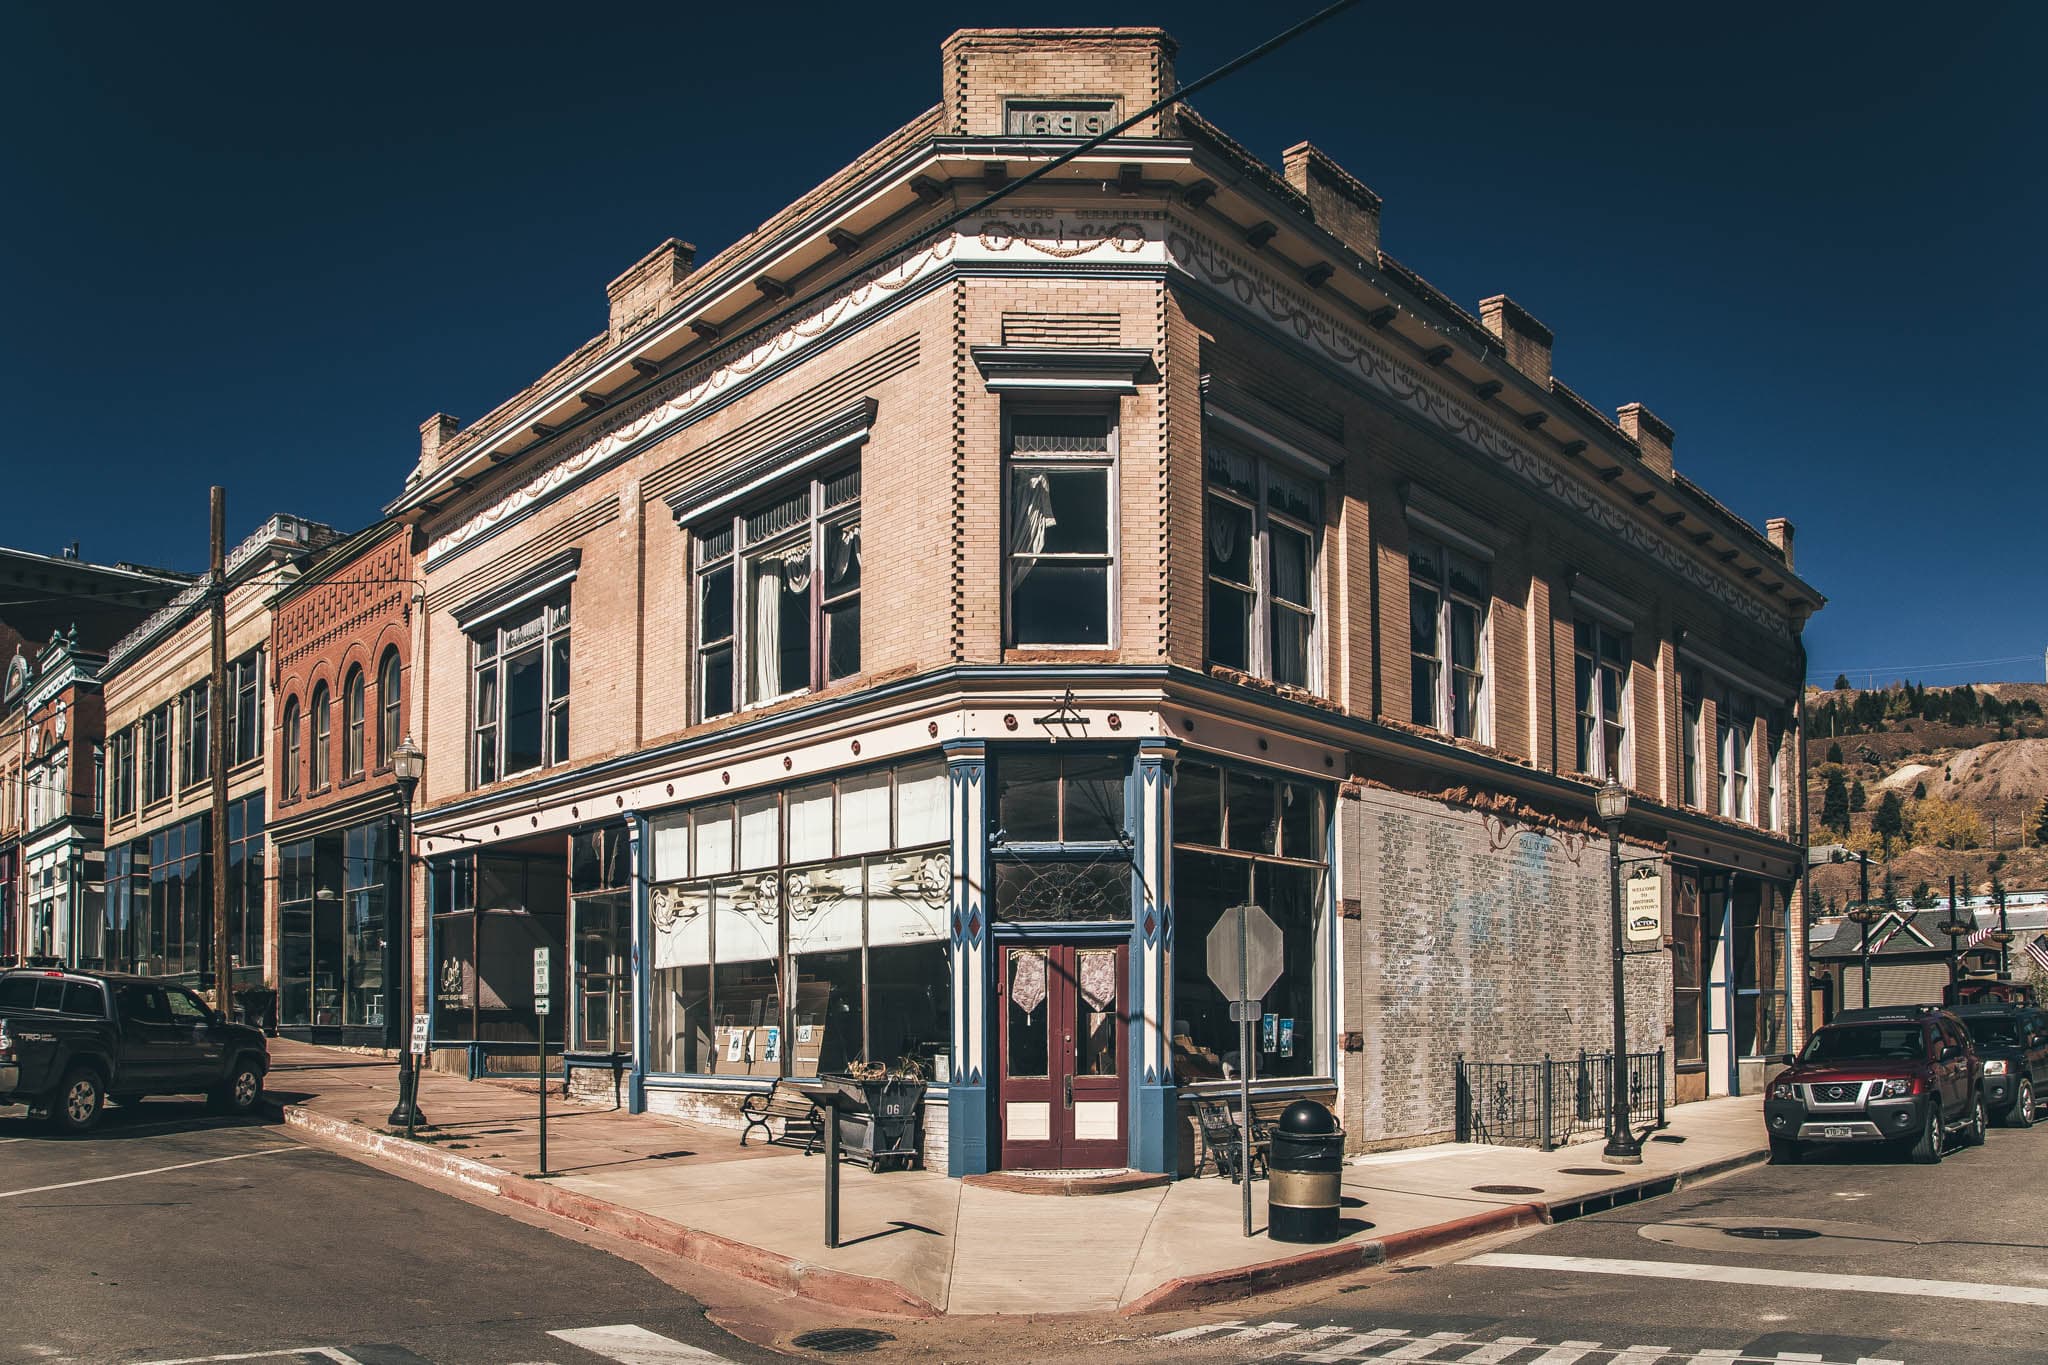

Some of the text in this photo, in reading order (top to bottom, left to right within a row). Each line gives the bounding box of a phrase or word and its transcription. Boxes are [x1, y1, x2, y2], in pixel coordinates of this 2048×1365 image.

[1014, 113, 1105, 136] 1899
[1520, 838, 1532, 850] ROLL
[1638, 868, 1650, 880] V
[1631, 885, 1656, 893] WELCOME
[1630, 919, 1657, 929] VICTOR
[18, 1033, 41, 1041] TRD
[886, 1104, 900, 1115] 06
